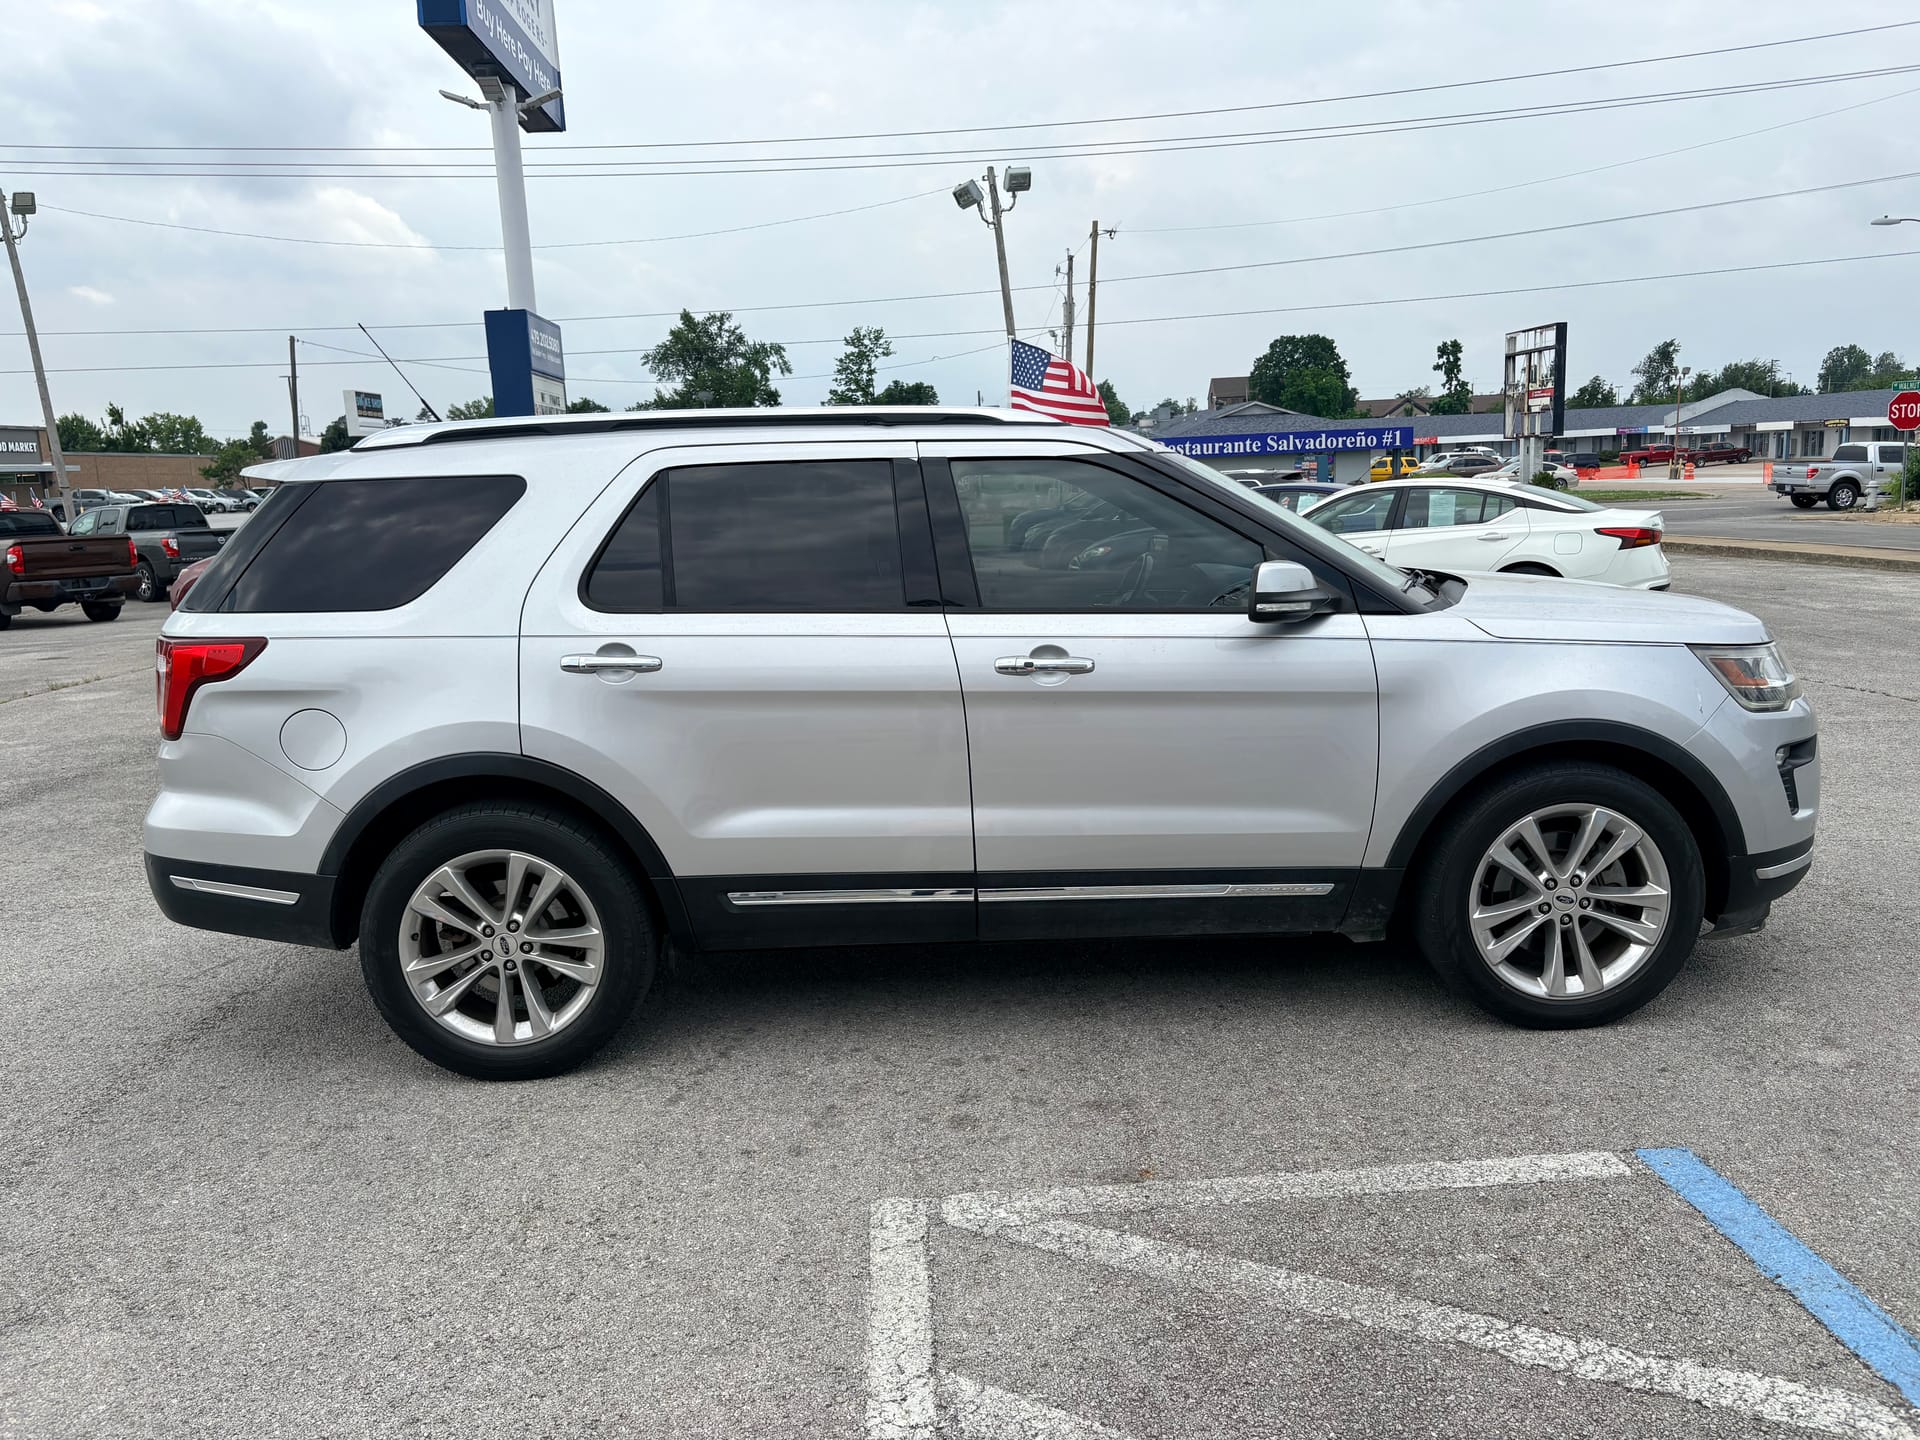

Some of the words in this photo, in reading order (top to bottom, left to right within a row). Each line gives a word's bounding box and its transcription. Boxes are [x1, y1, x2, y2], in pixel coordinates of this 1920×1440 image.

[477, 0, 494, 37] Buy
[496, 16, 516, 58] Here
[518, 41, 533, 81] Pay
[8, 442, 37, 453] MARKET
[1266, 431, 1377, 452] Salvadoreño
[1382, 430, 1402, 446] #1
